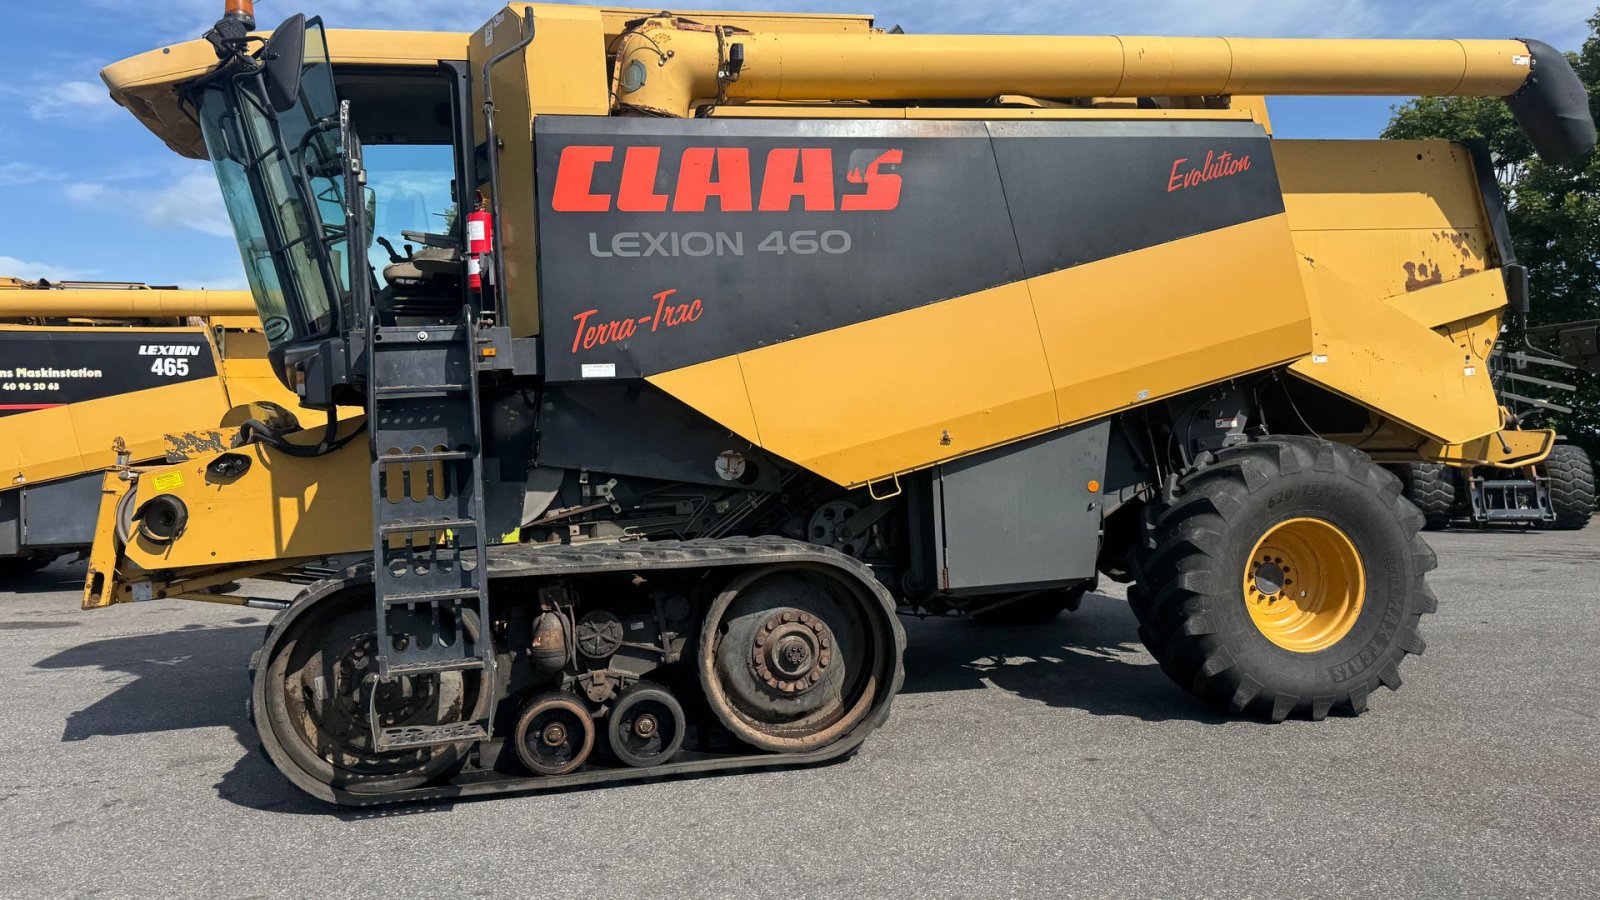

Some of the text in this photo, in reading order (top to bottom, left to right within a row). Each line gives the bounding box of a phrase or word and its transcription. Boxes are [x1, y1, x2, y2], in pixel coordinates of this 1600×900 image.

[551, 145, 904, 212] CLAAS
[1167, 149, 1251, 192] Evolution
[588, 229, 852, 258] LEXION 460
[571, 288, 704, 354] Terra-Trac
[138, 345, 201, 356] LEXION
[15, 367, 103, 379] Maskinstation
[151, 357, 189, 376] 465
[2, 382, 16, 391] 40
[18, 382, 31, 391] 96
[33, 382, 46, 391] 20
